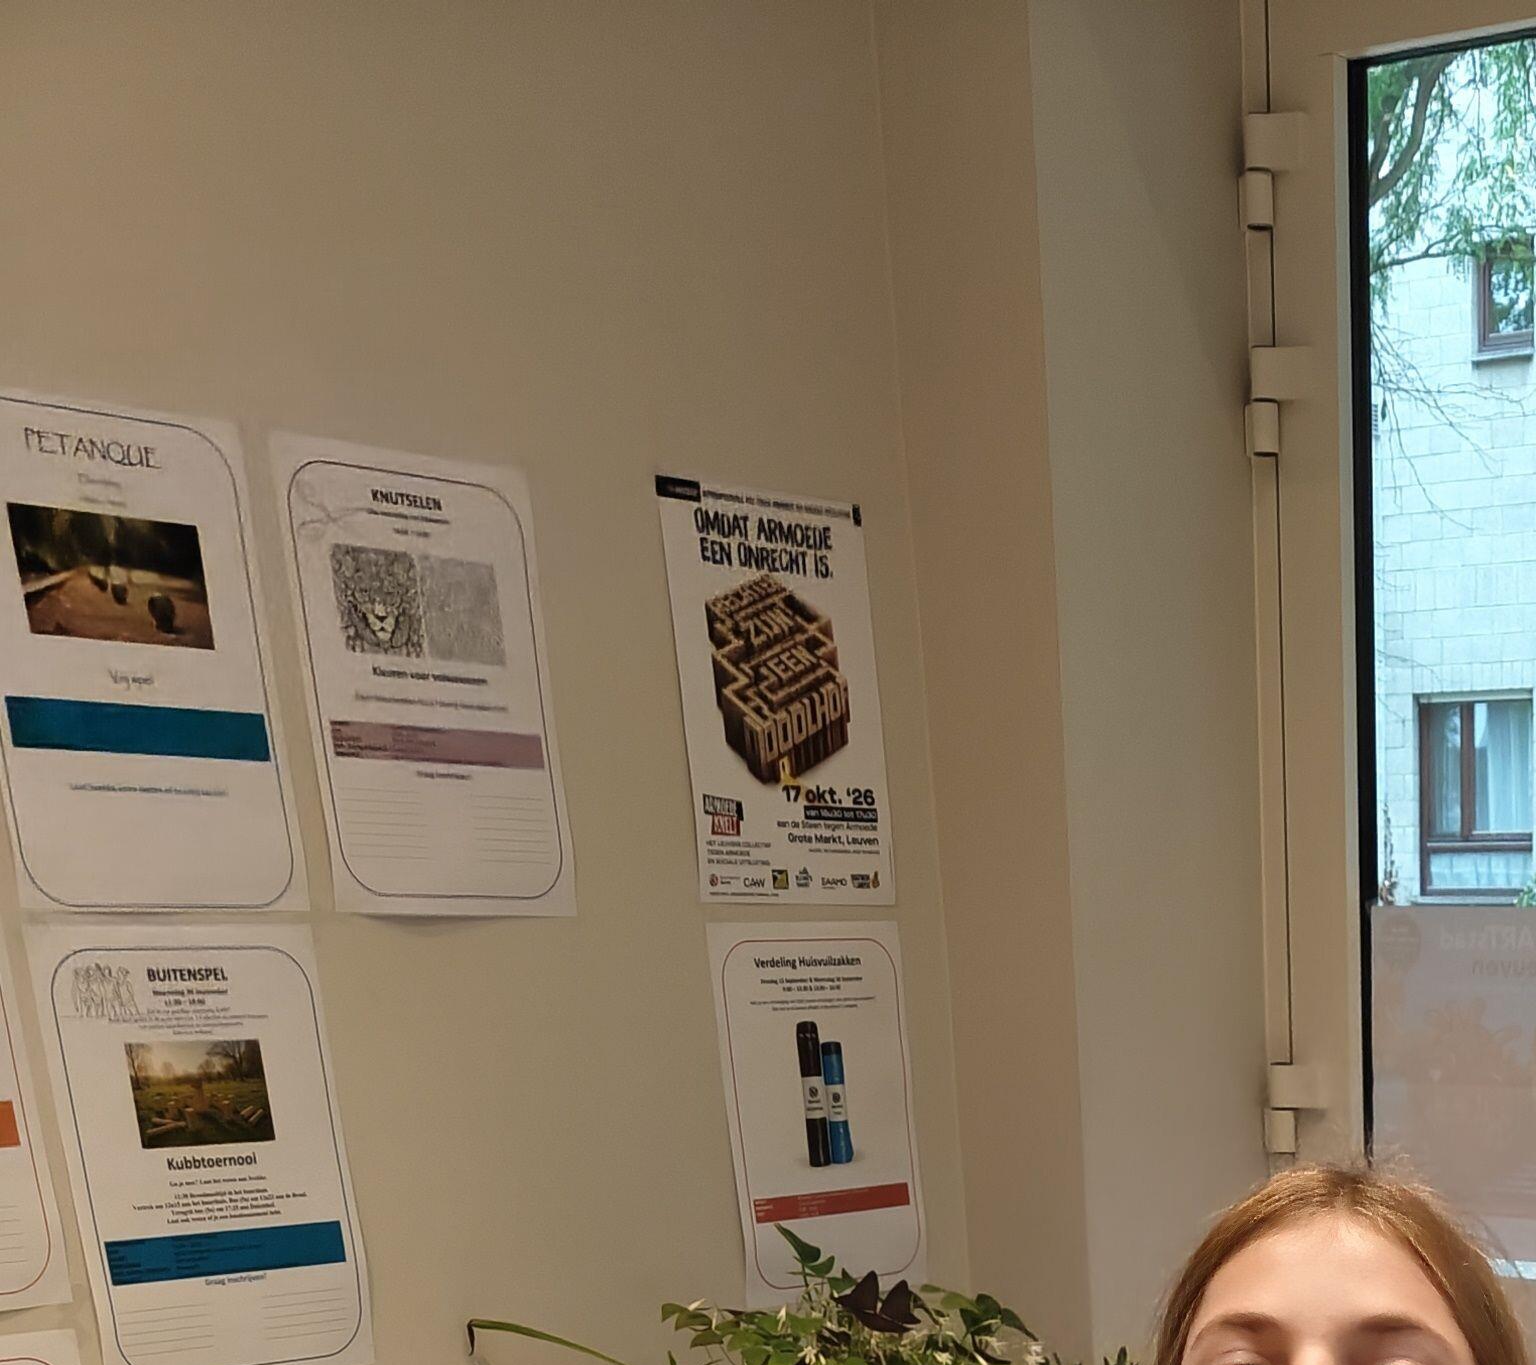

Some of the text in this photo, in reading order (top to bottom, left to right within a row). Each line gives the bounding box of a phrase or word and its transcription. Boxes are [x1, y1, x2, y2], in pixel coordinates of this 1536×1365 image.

[24, 427, 162, 469] PETANQUE
[371, 489, 442, 511] KNUTSELEN
[693, 507, 833, 550] OMDAT ARMOEDE
[699, 537, 833, 579] EEN ONRECHT IS.
[782, 785, 800, 802] 17
[805, 784, 842, 805] okt.
[847, 835, 879, 845] Leuven
[754, 956, 861, 969] Verdeling Huisvuilzakken
[147, 967, 228, 982] BUITENSPEL
[167, 1152, 258, 1171] Kubbtoernooi
